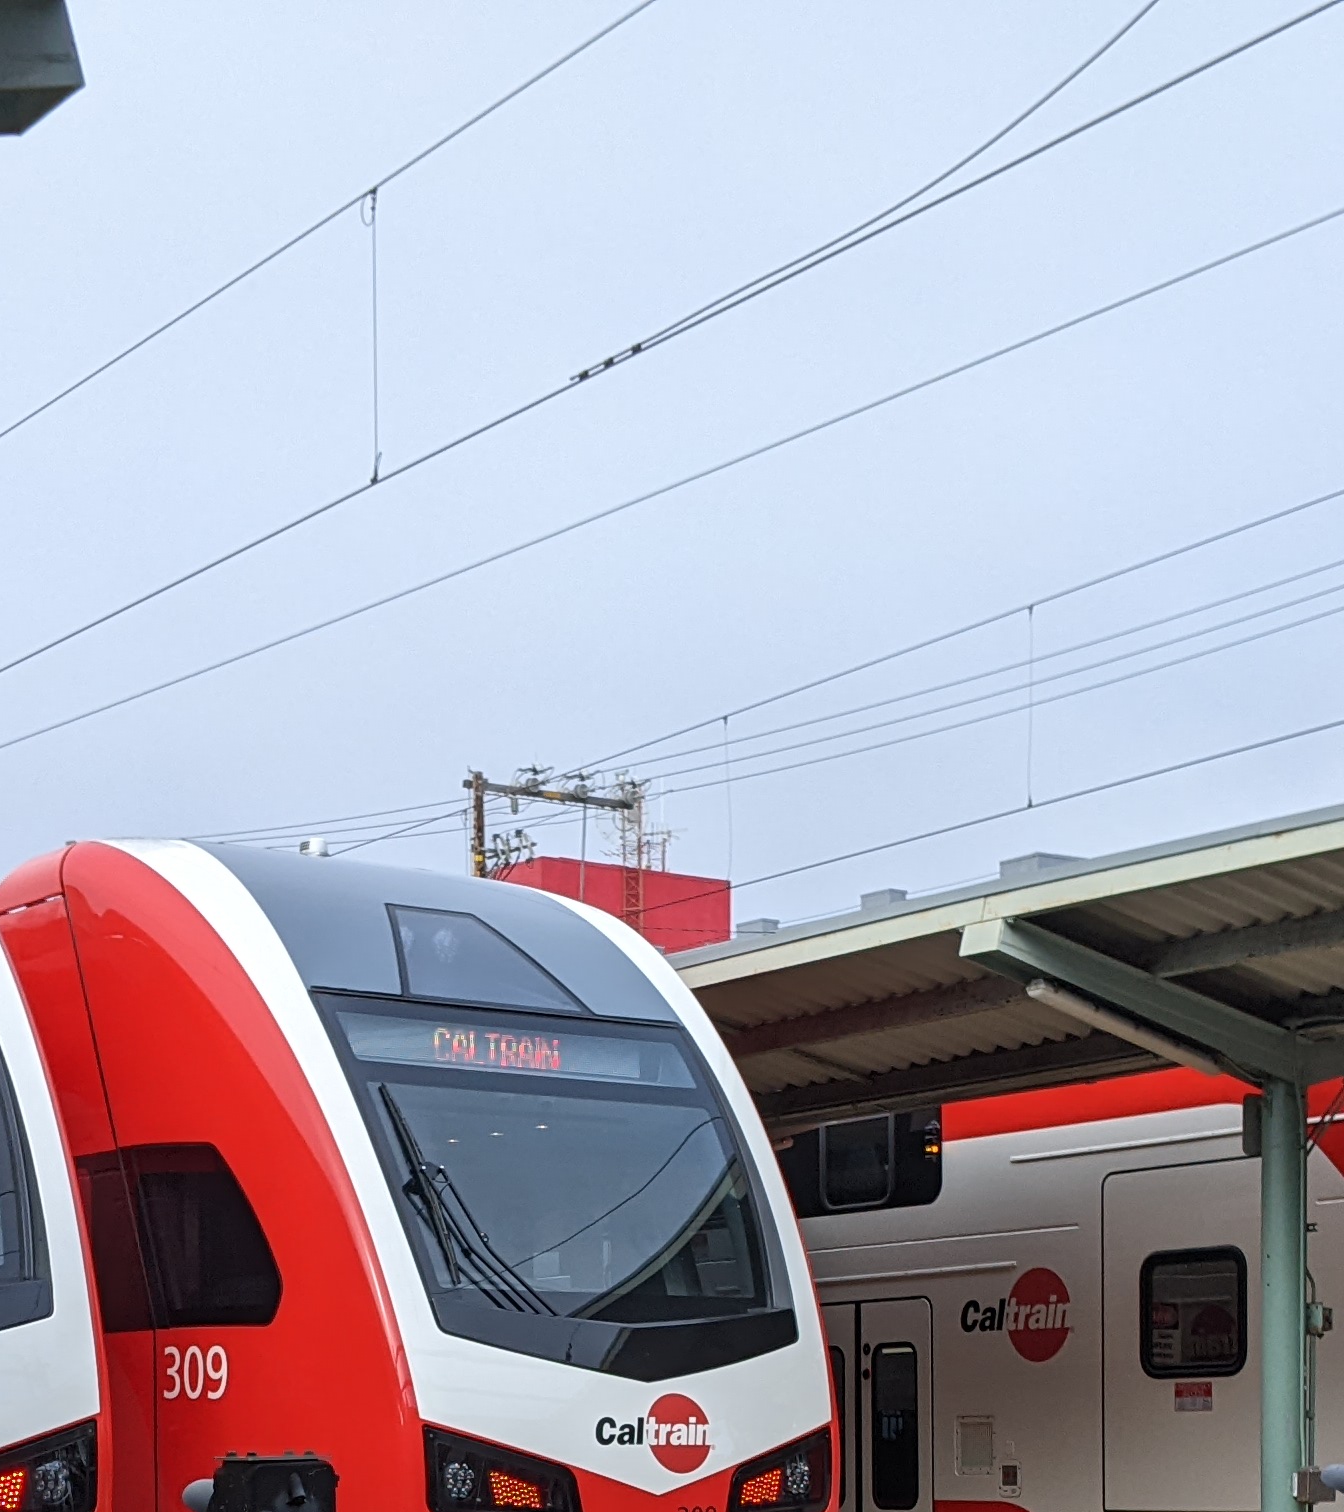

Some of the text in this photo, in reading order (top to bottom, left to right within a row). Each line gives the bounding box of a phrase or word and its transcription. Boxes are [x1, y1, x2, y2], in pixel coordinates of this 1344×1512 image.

[433, 1028, 560, 1070] CALTRAIN
[960, 1295, 1071, 1333] Caltrain
[163, 1345, 228, 1400] 309
[595, 1416, 711, 1446] Caltrain
